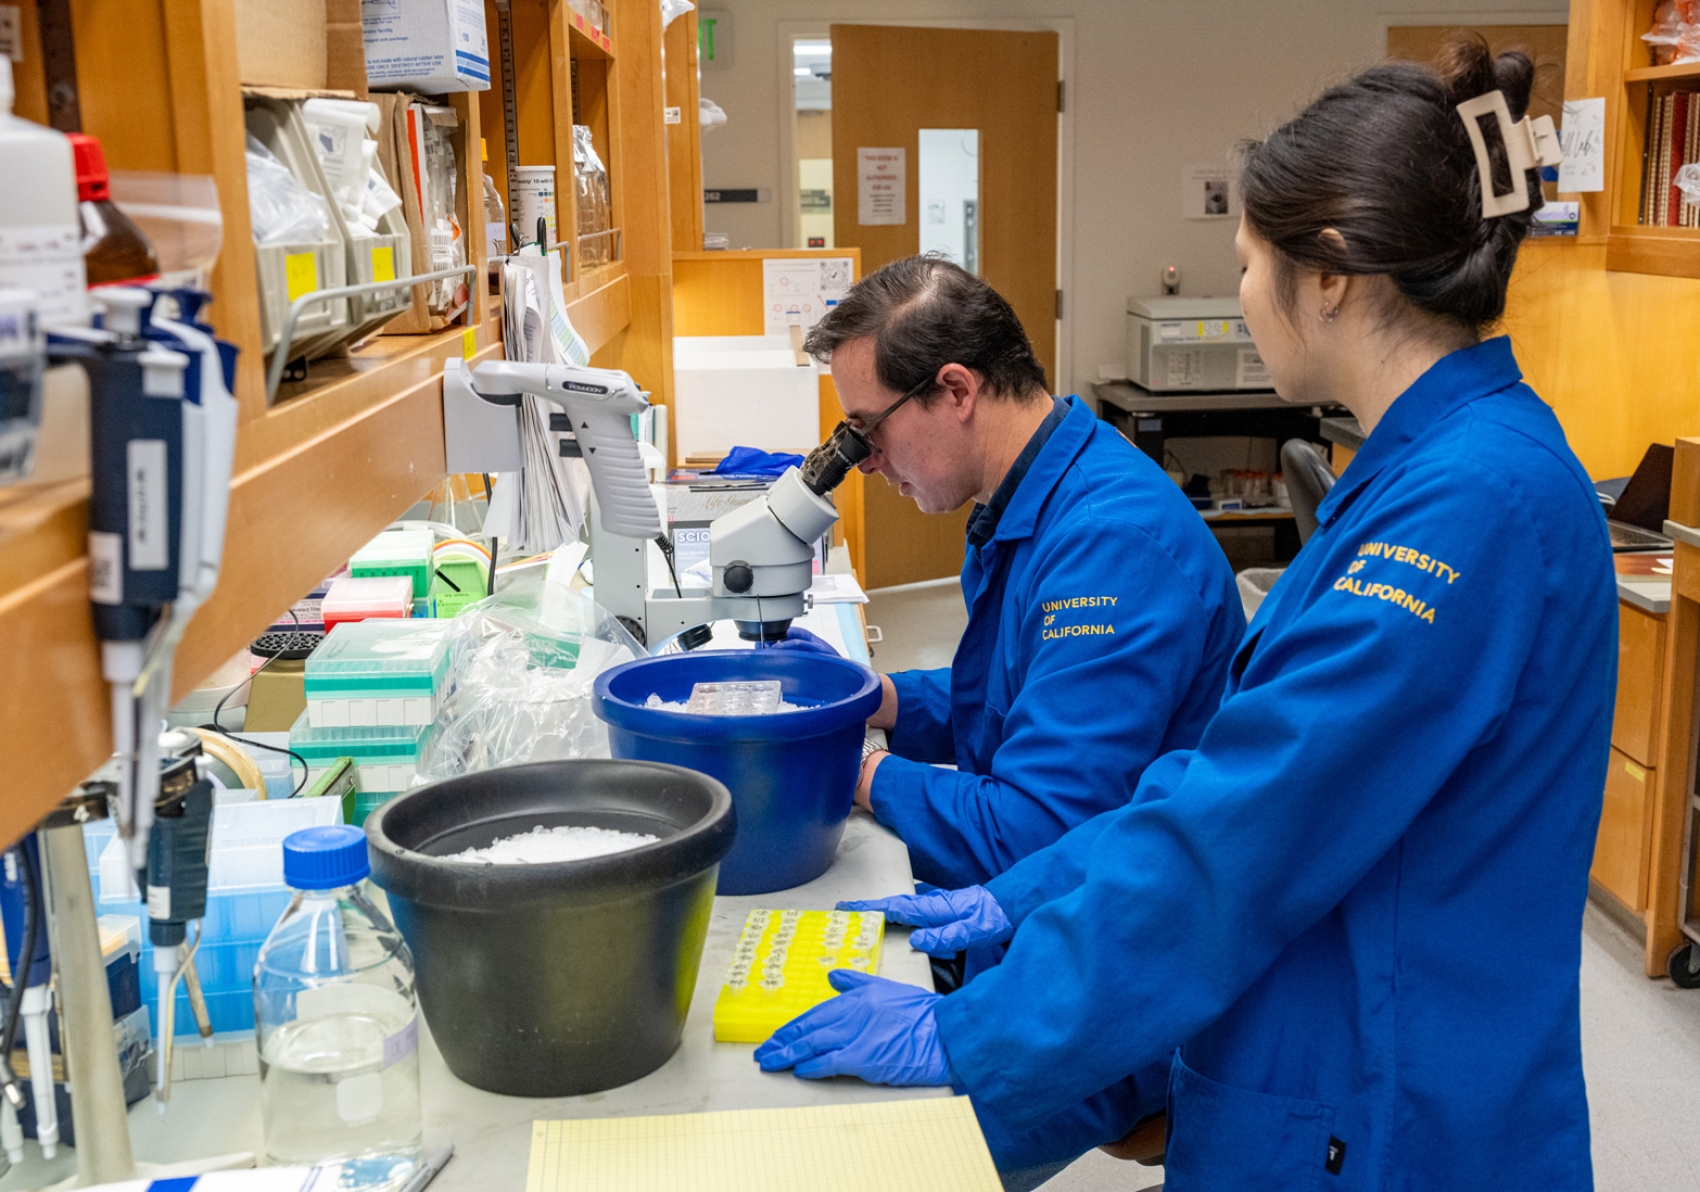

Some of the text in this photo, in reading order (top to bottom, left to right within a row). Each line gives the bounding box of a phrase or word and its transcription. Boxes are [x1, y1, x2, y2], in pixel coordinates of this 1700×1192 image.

[1347, 559, 1366, 574] OF
[1358, 542, 1460, 584] UNIVERSITY
[1042, 596, 1118, 612] UNIVERSITY
[1333, 576, 1435, 624] CALIFORNIA
[1044, 614, 1056, 626] OF
[1042, 624, 1115, 640] CALIFORNIA
